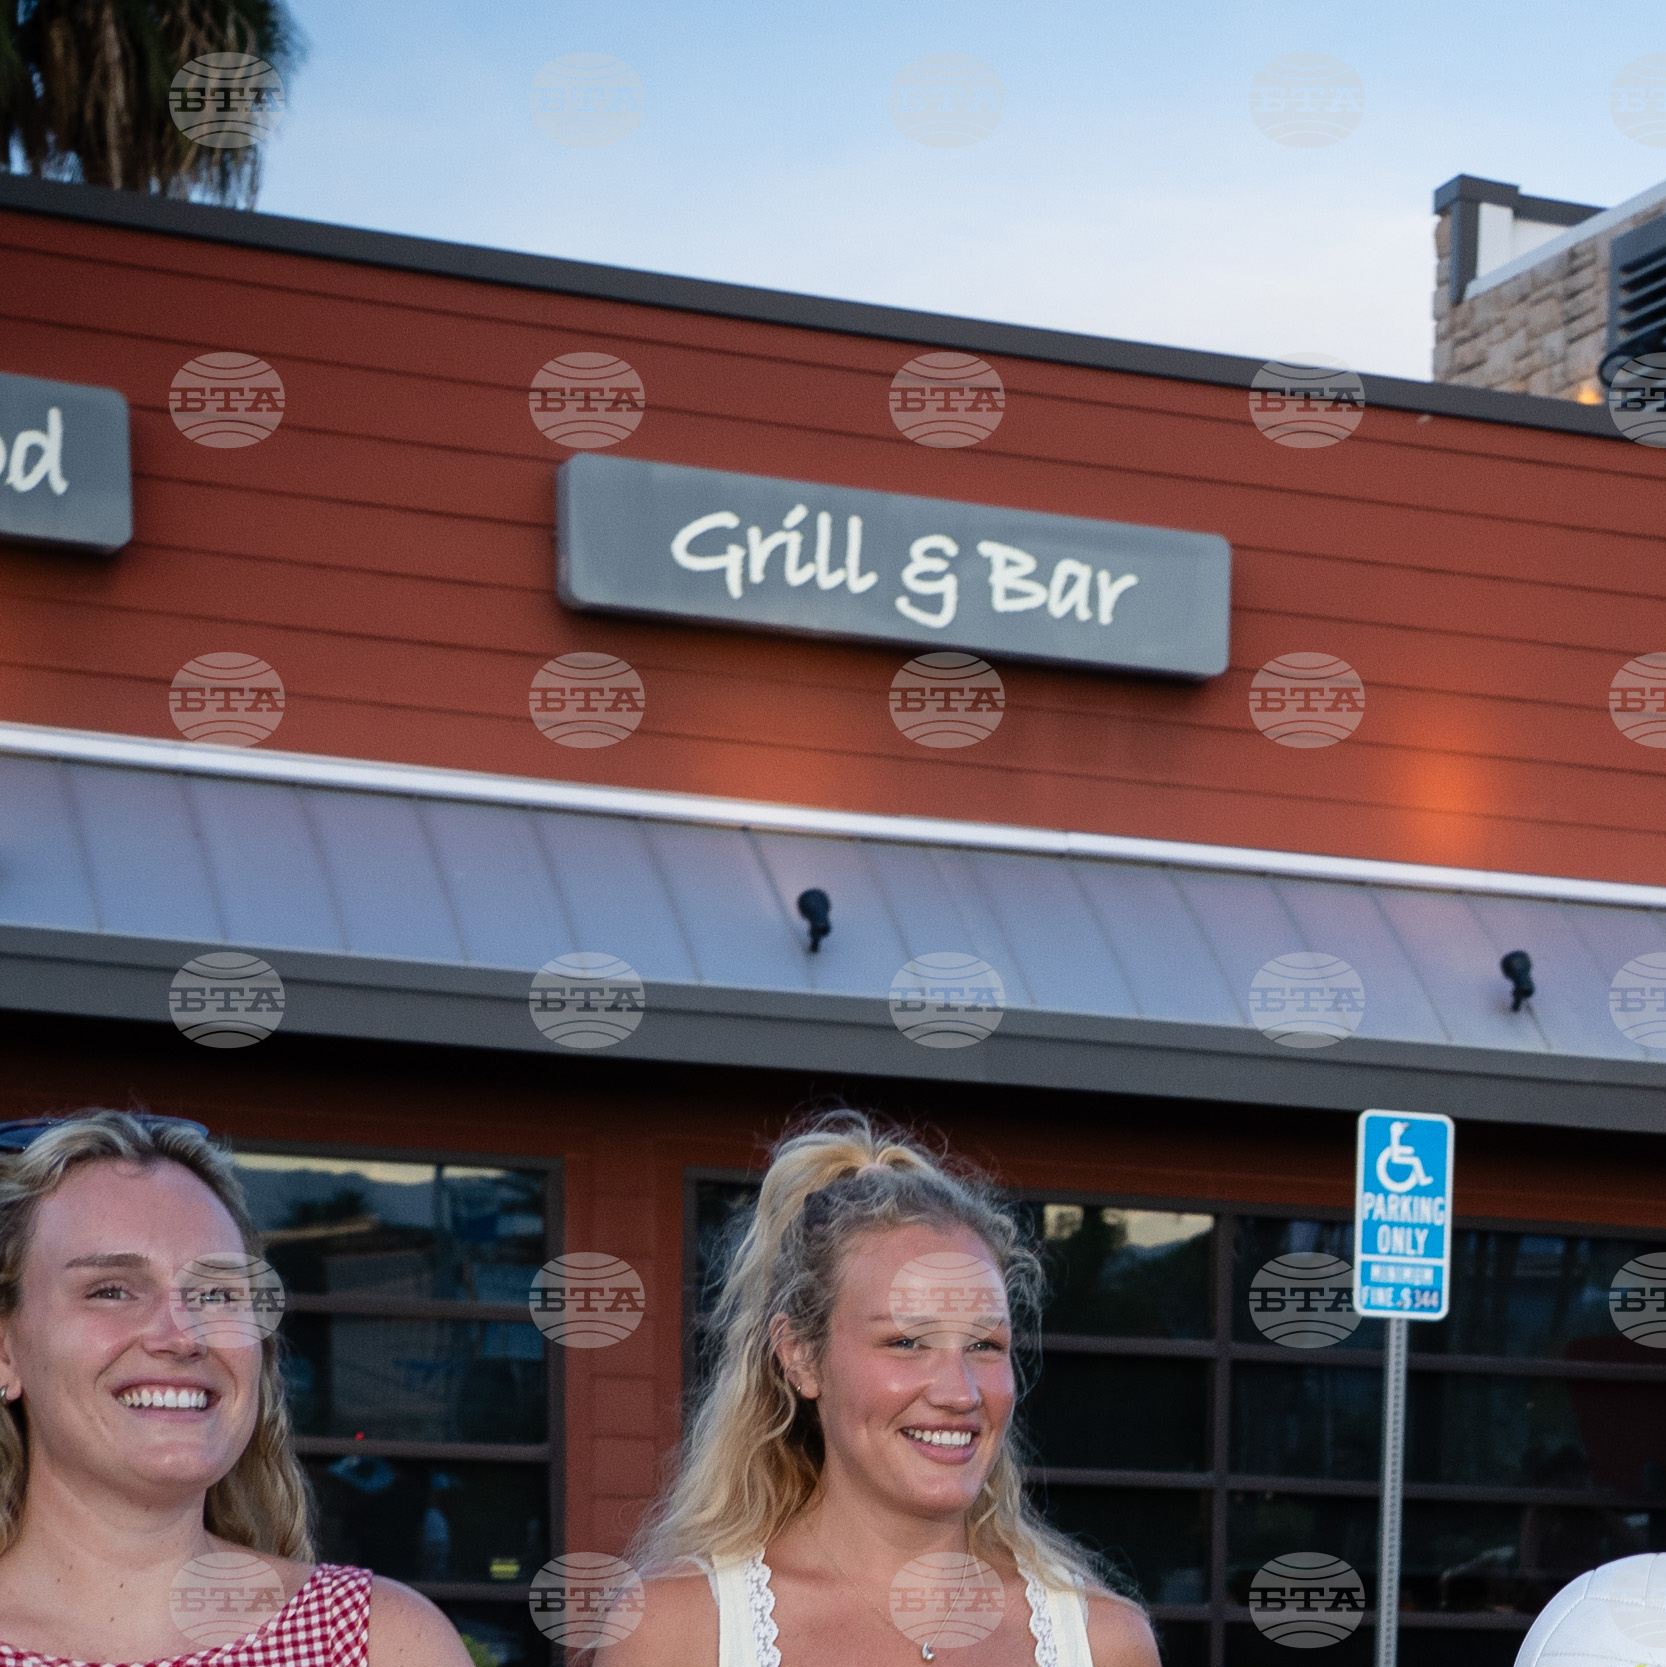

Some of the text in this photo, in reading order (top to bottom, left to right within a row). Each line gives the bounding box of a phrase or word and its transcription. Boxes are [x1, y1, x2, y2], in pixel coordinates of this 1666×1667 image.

[0, 405, 69, 496] d
[670, 504, 1139, 629] Grill & Bar
[1362, 1192, 1446, 1226] PARKING
[1377, 1224, 1429, 1256] ONLY
